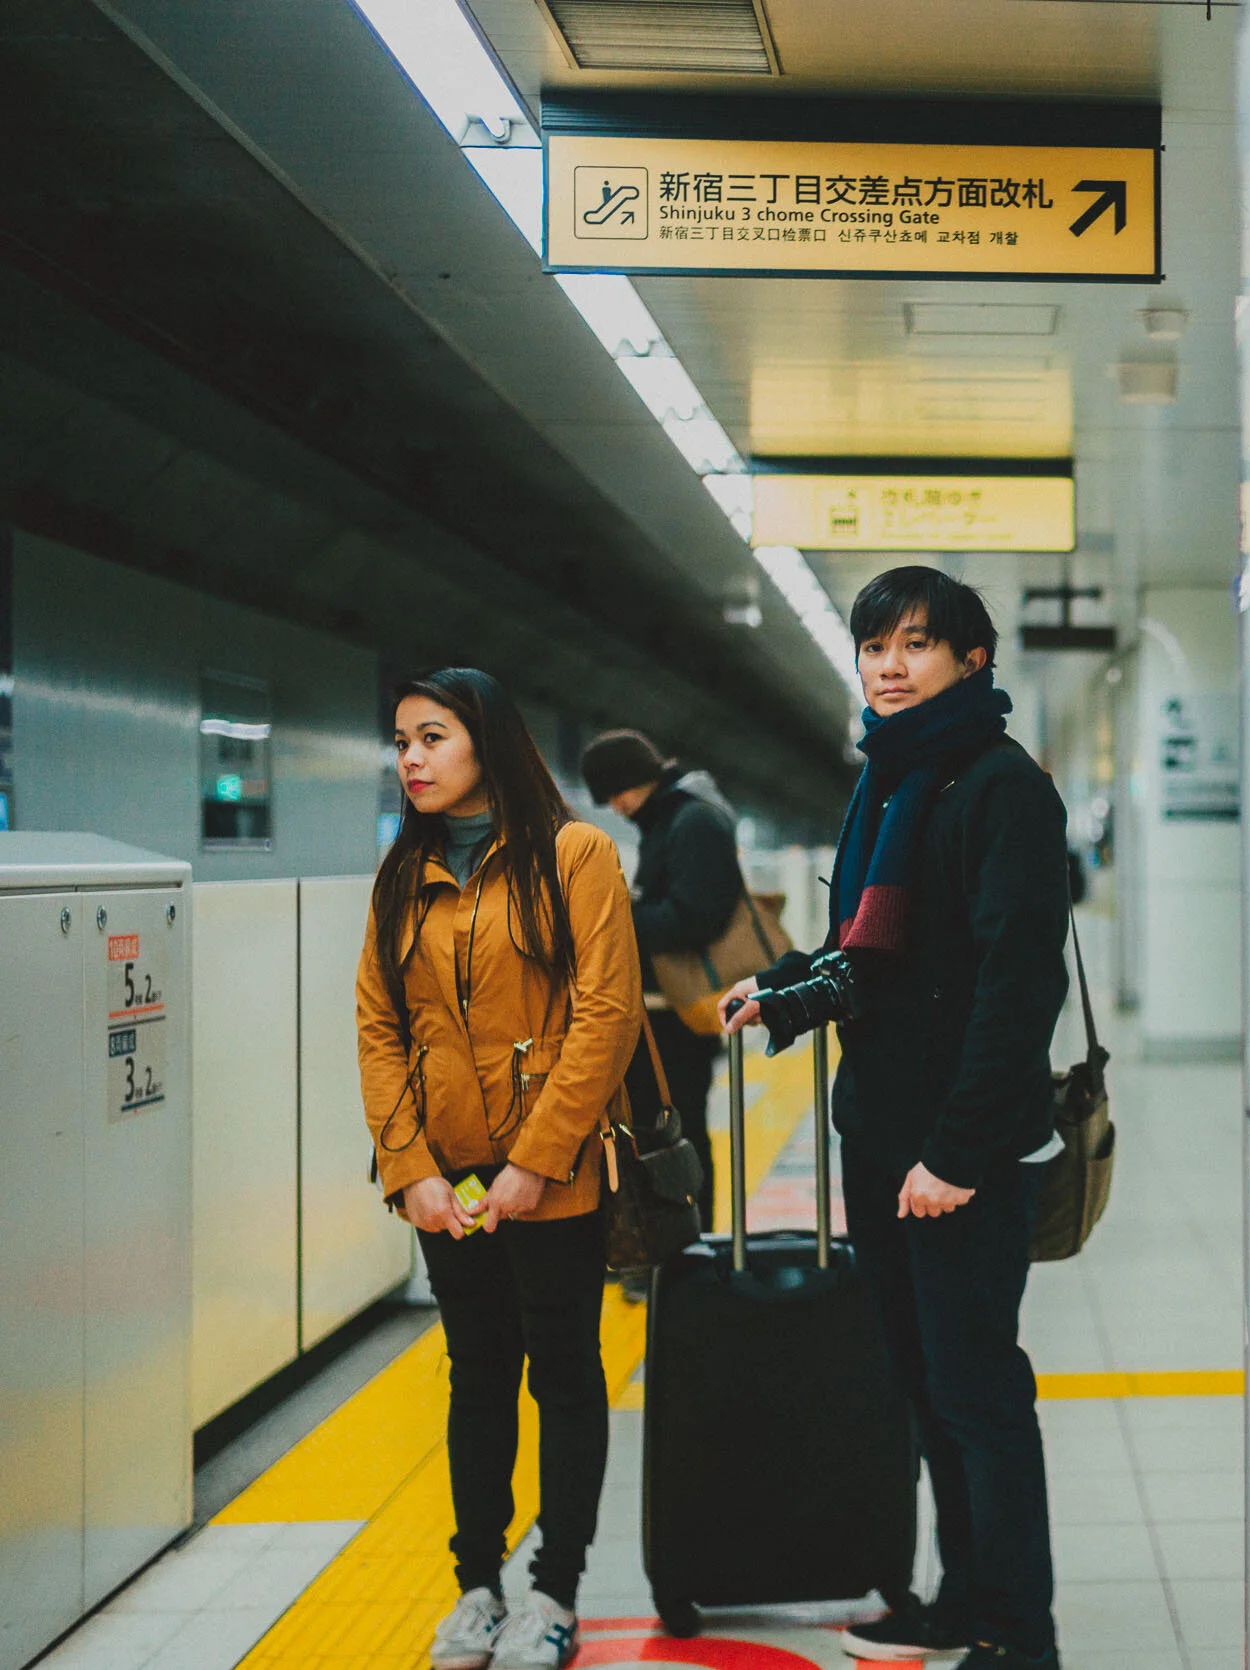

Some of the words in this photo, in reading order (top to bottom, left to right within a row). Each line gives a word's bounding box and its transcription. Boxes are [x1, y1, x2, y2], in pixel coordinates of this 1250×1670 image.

[659, 171, 1053, 208] 新宿三丁目交差点方面改札
[660, 205, 735, 223] Shinjuku
[742, 207, 750, 221] 3
[757, 207, 814, 222] chome
[820, 208, 893, 227] Crossing
[900, 210, 940, 224] Gate
[937, 231, 980, 245] 교차점
[990, 231, 1018, 246] 개찰
